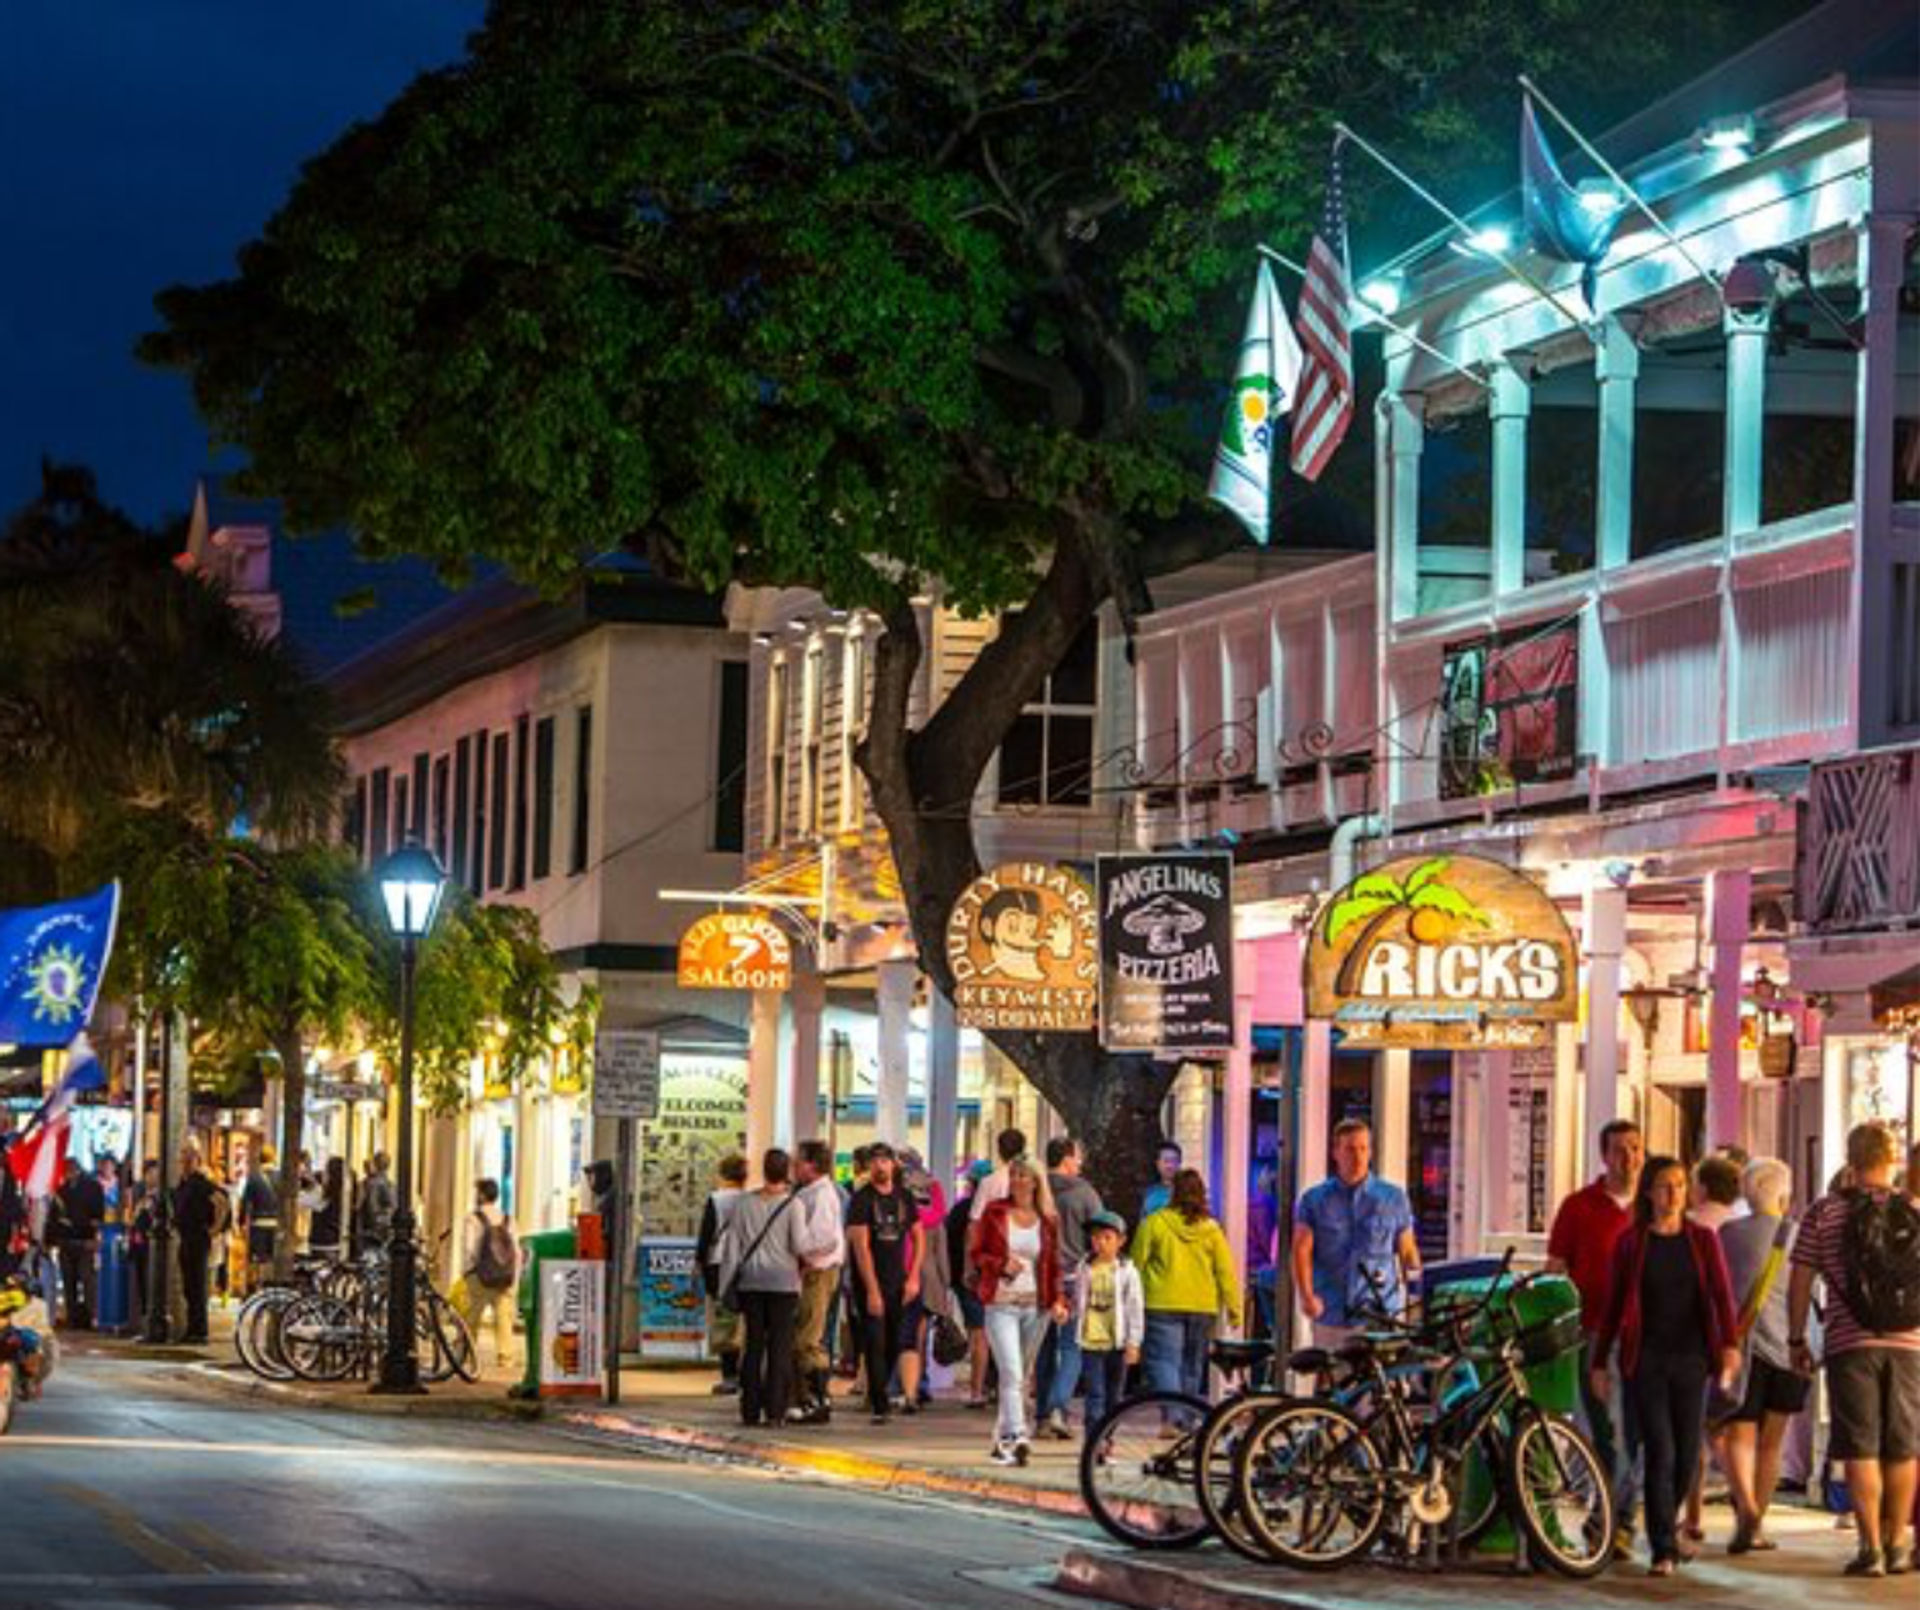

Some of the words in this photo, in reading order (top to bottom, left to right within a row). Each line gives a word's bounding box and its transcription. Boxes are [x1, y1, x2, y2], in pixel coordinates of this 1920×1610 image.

[1104, 865, 1223, 920] ANGELINA'S
[948, 871, 1000, 982] DURTY
[685, 966, 786, 989] SALOON
[1116, 941, 1220, 985] PIZZERIA
[1360, 938, 1559, 999] RICK'S
[661, 1115, 728, 1131] BIKERS
